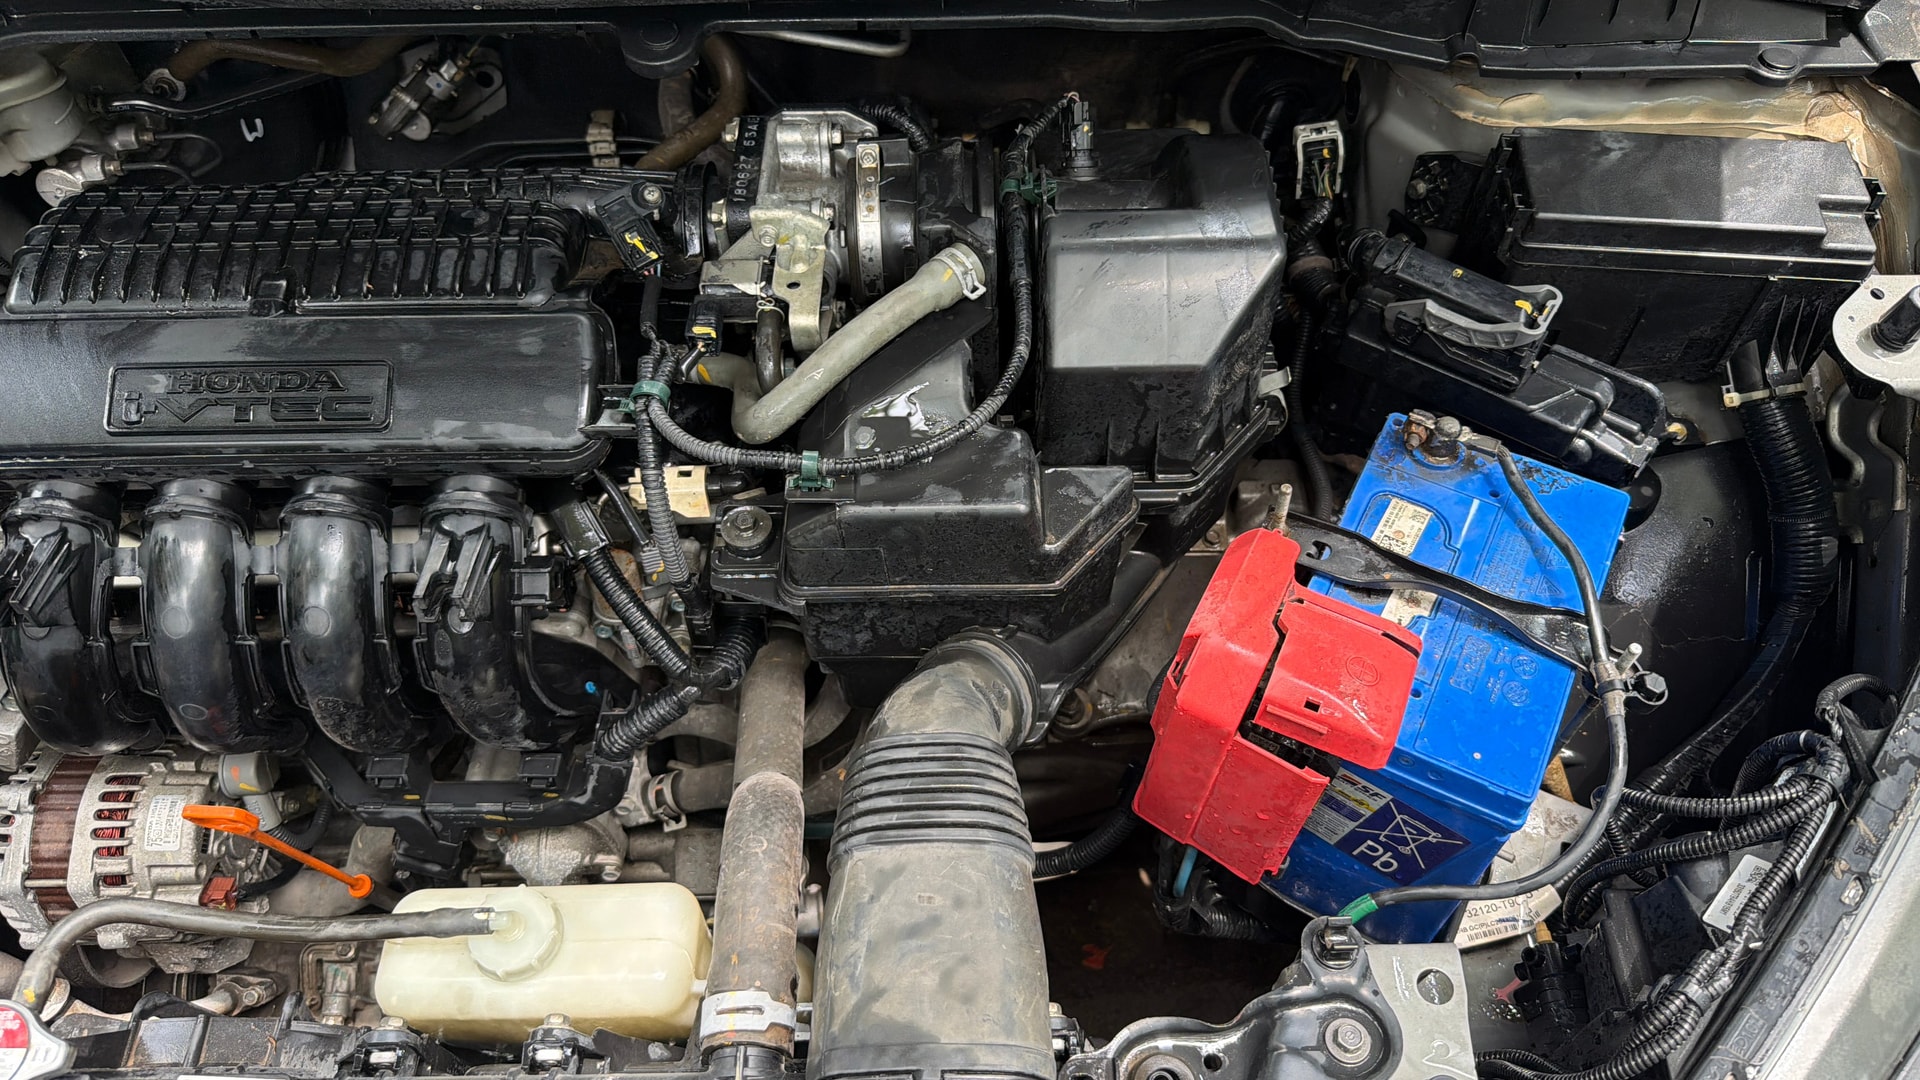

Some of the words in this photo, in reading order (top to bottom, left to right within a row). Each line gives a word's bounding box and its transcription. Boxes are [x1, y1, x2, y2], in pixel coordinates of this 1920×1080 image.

[167, 371, 347, 394] HONDA
[122, 391, 374, 425] i-VTEC
[1360, 784, 1387, 801] SF
[1351, 839, 1399, 872] Pb
